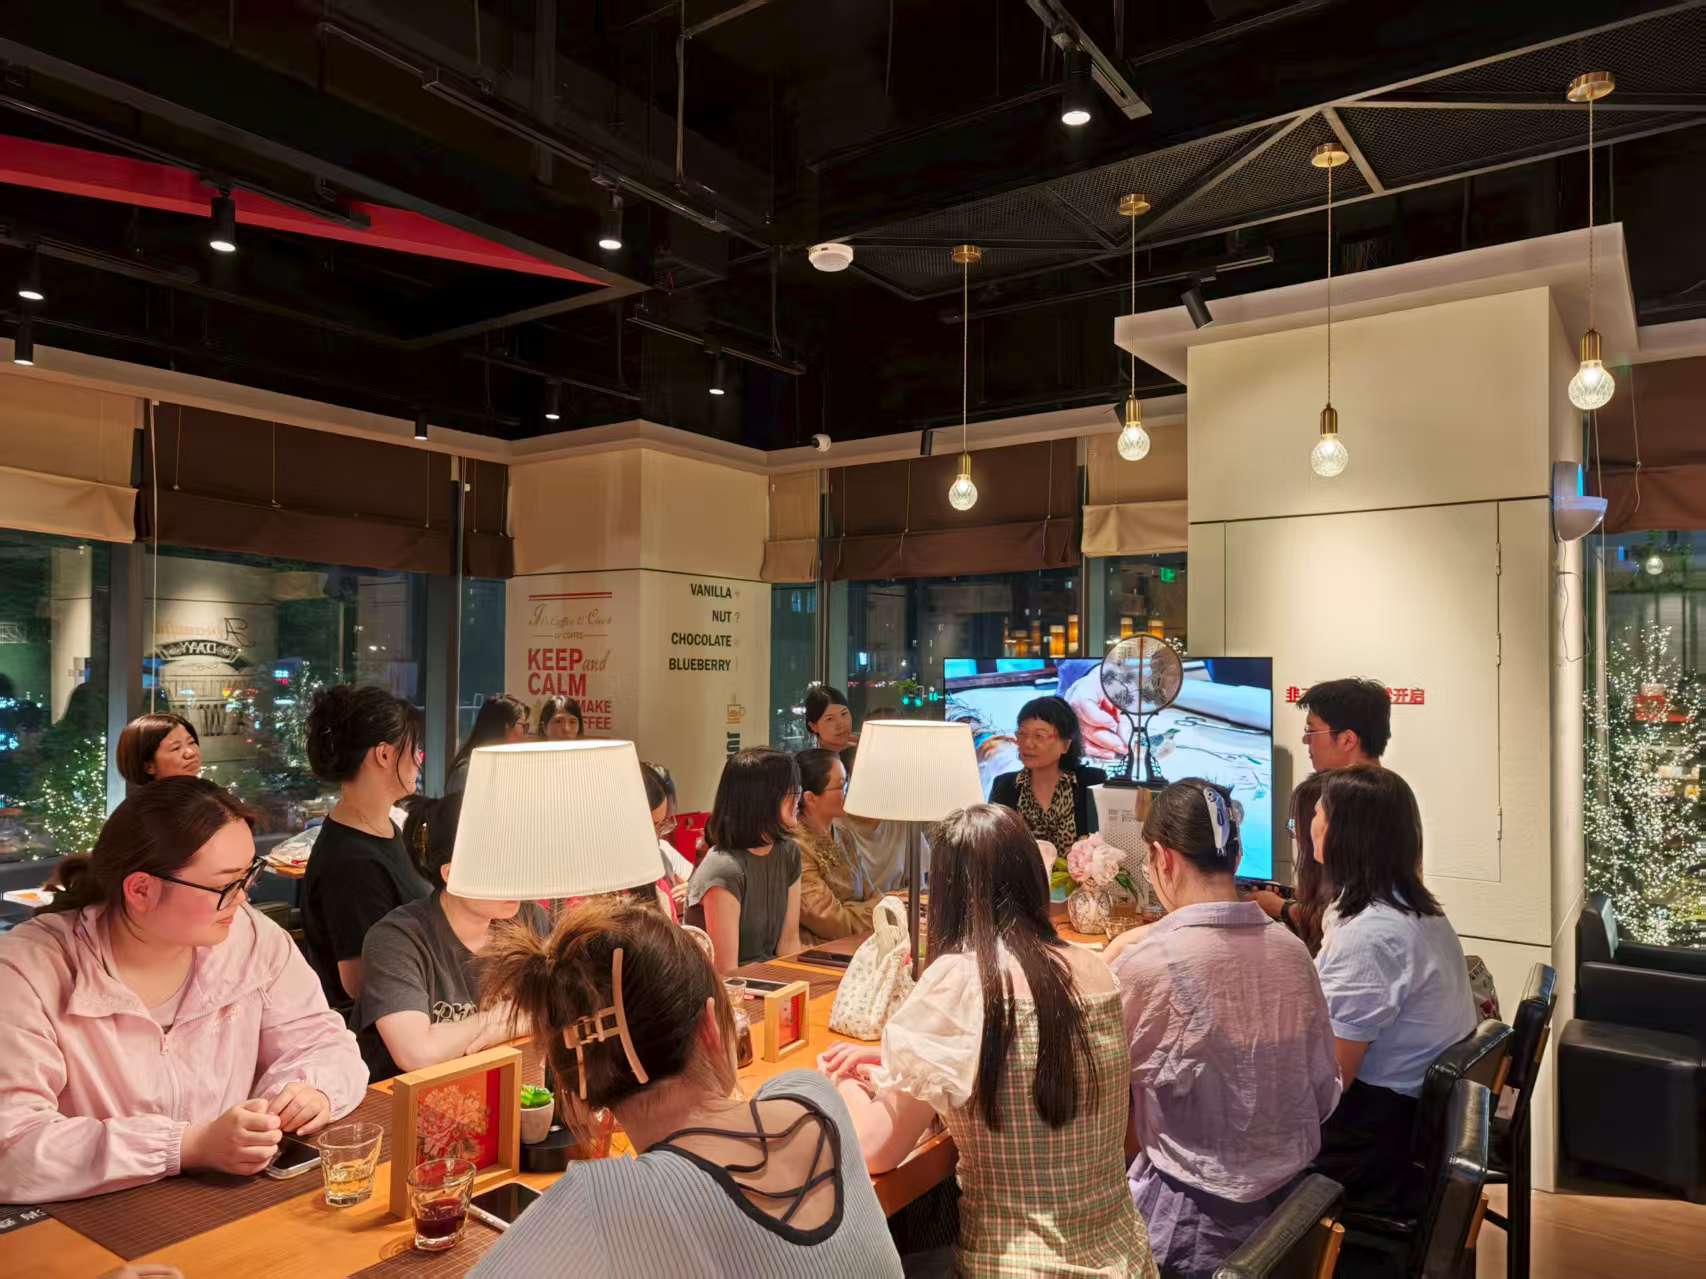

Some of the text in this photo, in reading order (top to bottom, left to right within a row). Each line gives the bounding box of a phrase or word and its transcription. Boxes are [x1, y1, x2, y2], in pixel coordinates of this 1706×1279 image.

[690, 583, 732, 599] VANILLA
[712, 609, 732, 623] NUT
[671, 632, 732, 647] CHOCOLATE
[527, 648, 611, 672] KEEP and
[668, 657, 731, 671] BLUEBERRY
[527, 672, 586, 697] CALM
